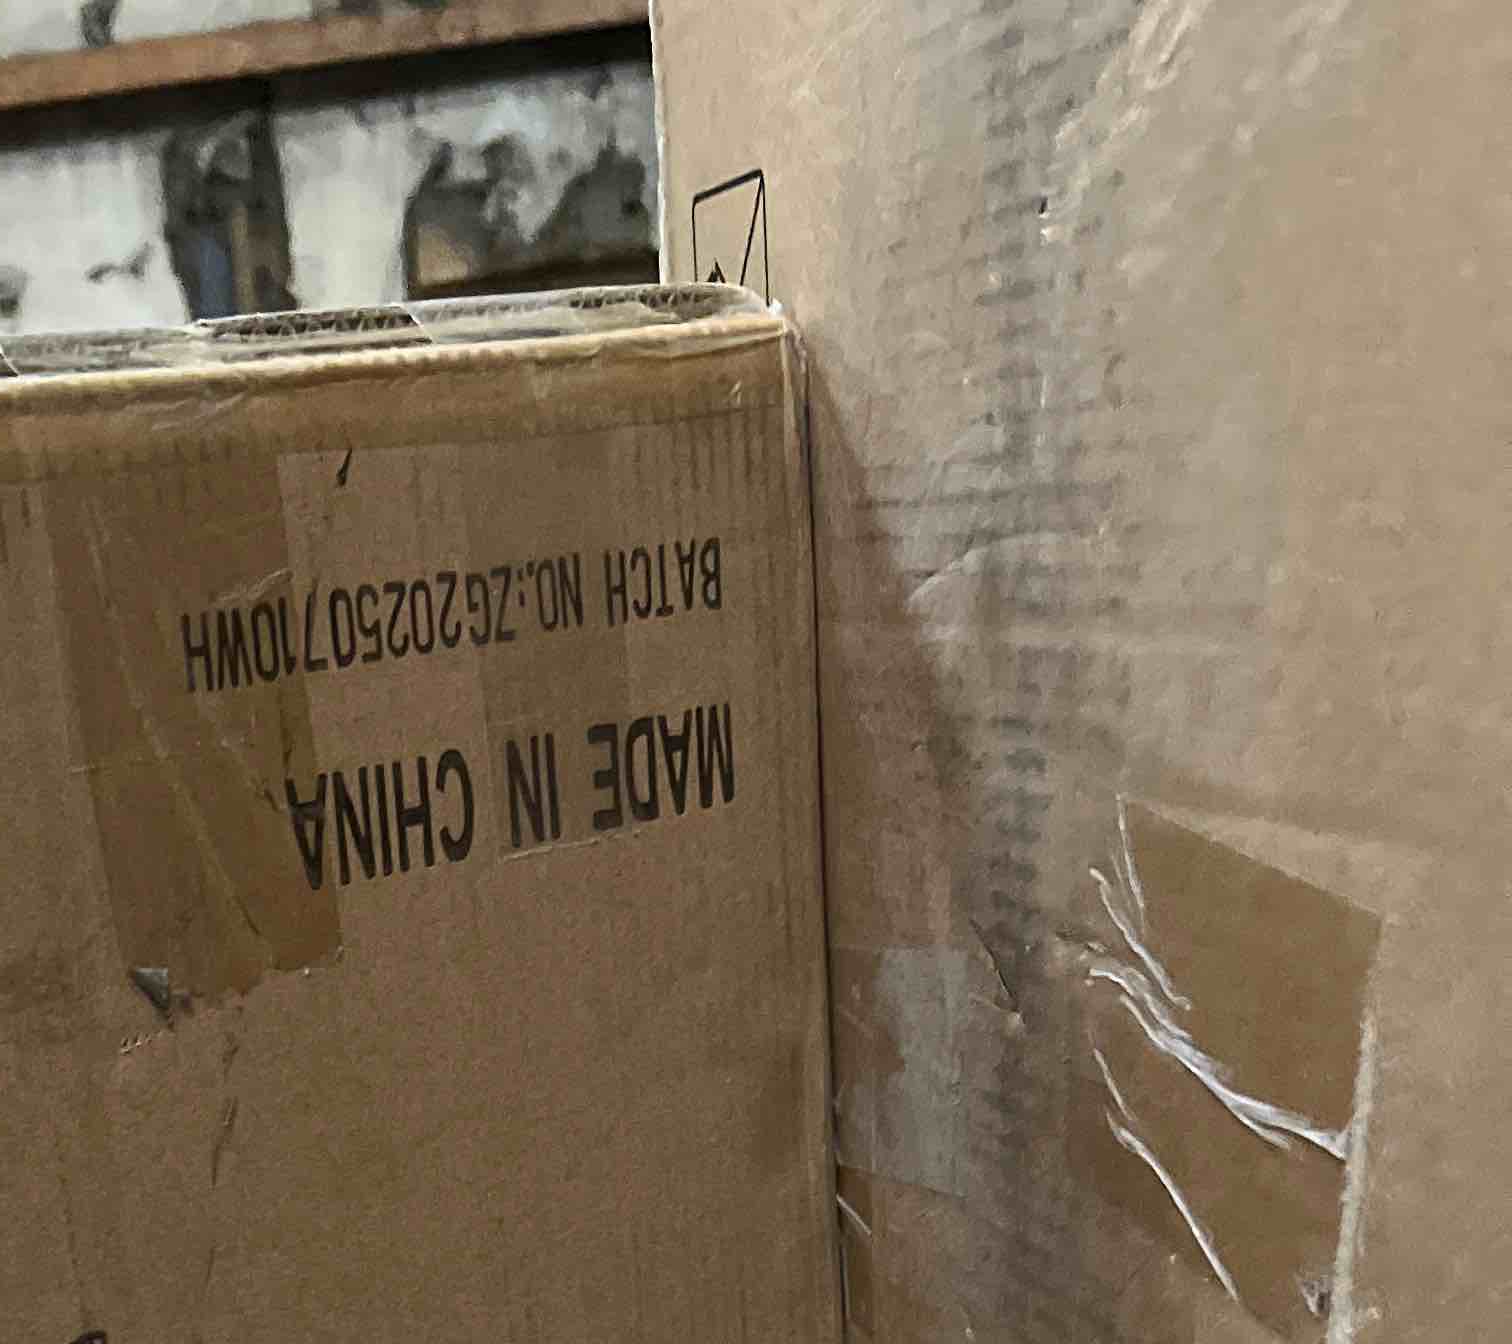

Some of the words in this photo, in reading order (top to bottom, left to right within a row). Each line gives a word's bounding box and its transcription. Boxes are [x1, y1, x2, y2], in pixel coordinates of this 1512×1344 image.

[604, 537, 723, 628] BATCH
[285, 749, 475, 891] CHINA
[506, 733, 562, 848] IN
[587, 703, 735, 832] MADE
